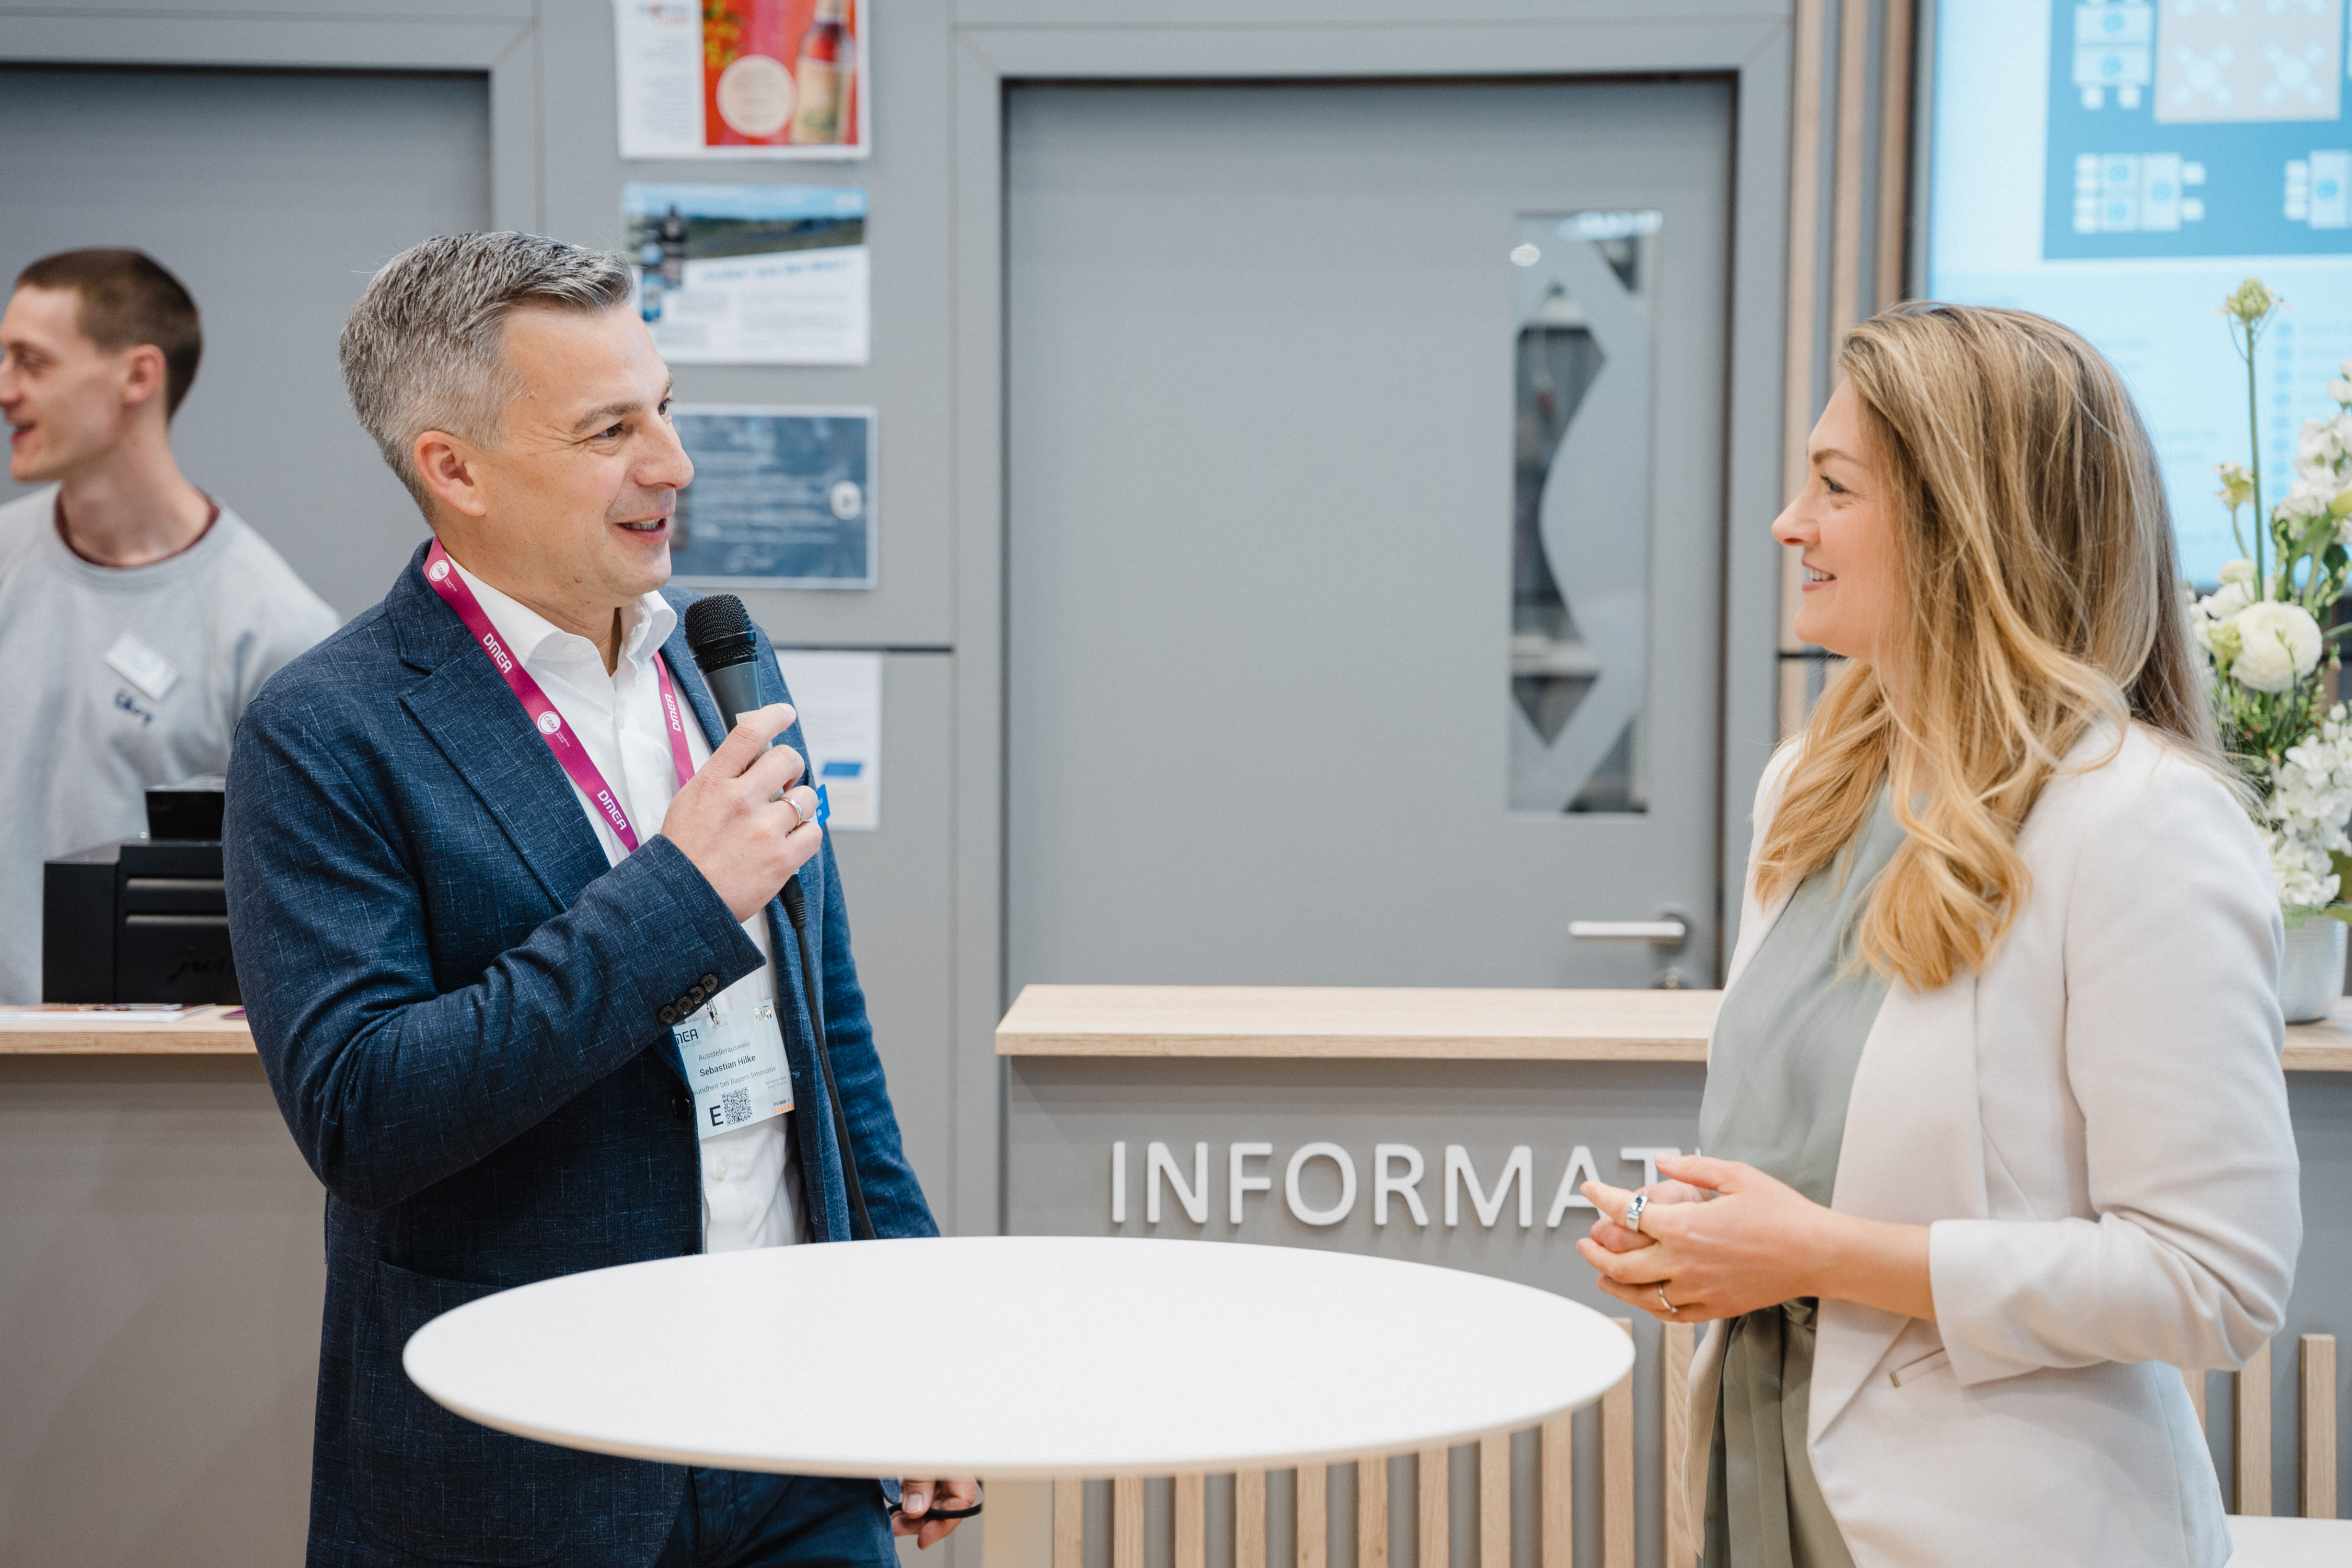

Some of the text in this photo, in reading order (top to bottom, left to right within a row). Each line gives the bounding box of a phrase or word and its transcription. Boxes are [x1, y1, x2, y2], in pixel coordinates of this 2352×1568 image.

[435, 564, 445, 577] CGM
[482, 632, 513, 674] DMEA
[544, 716, 557, 730] CGM
[664, 693, 682, 732] DMEA
[597, 790, 627, 831] DMEA
[674, 1029, 699, 1045] MEA
[698, 1041, 751, 1062] Ausstellerausweis
[699, 1055, 756, 1077] Sebastian Hilke
[693, 1065, 777, 1097] sundheit bei Bayern Innovativ
[709, 1105, 724, 1127] E
[1112, 1140, 1701, 1227] INFORMAT
